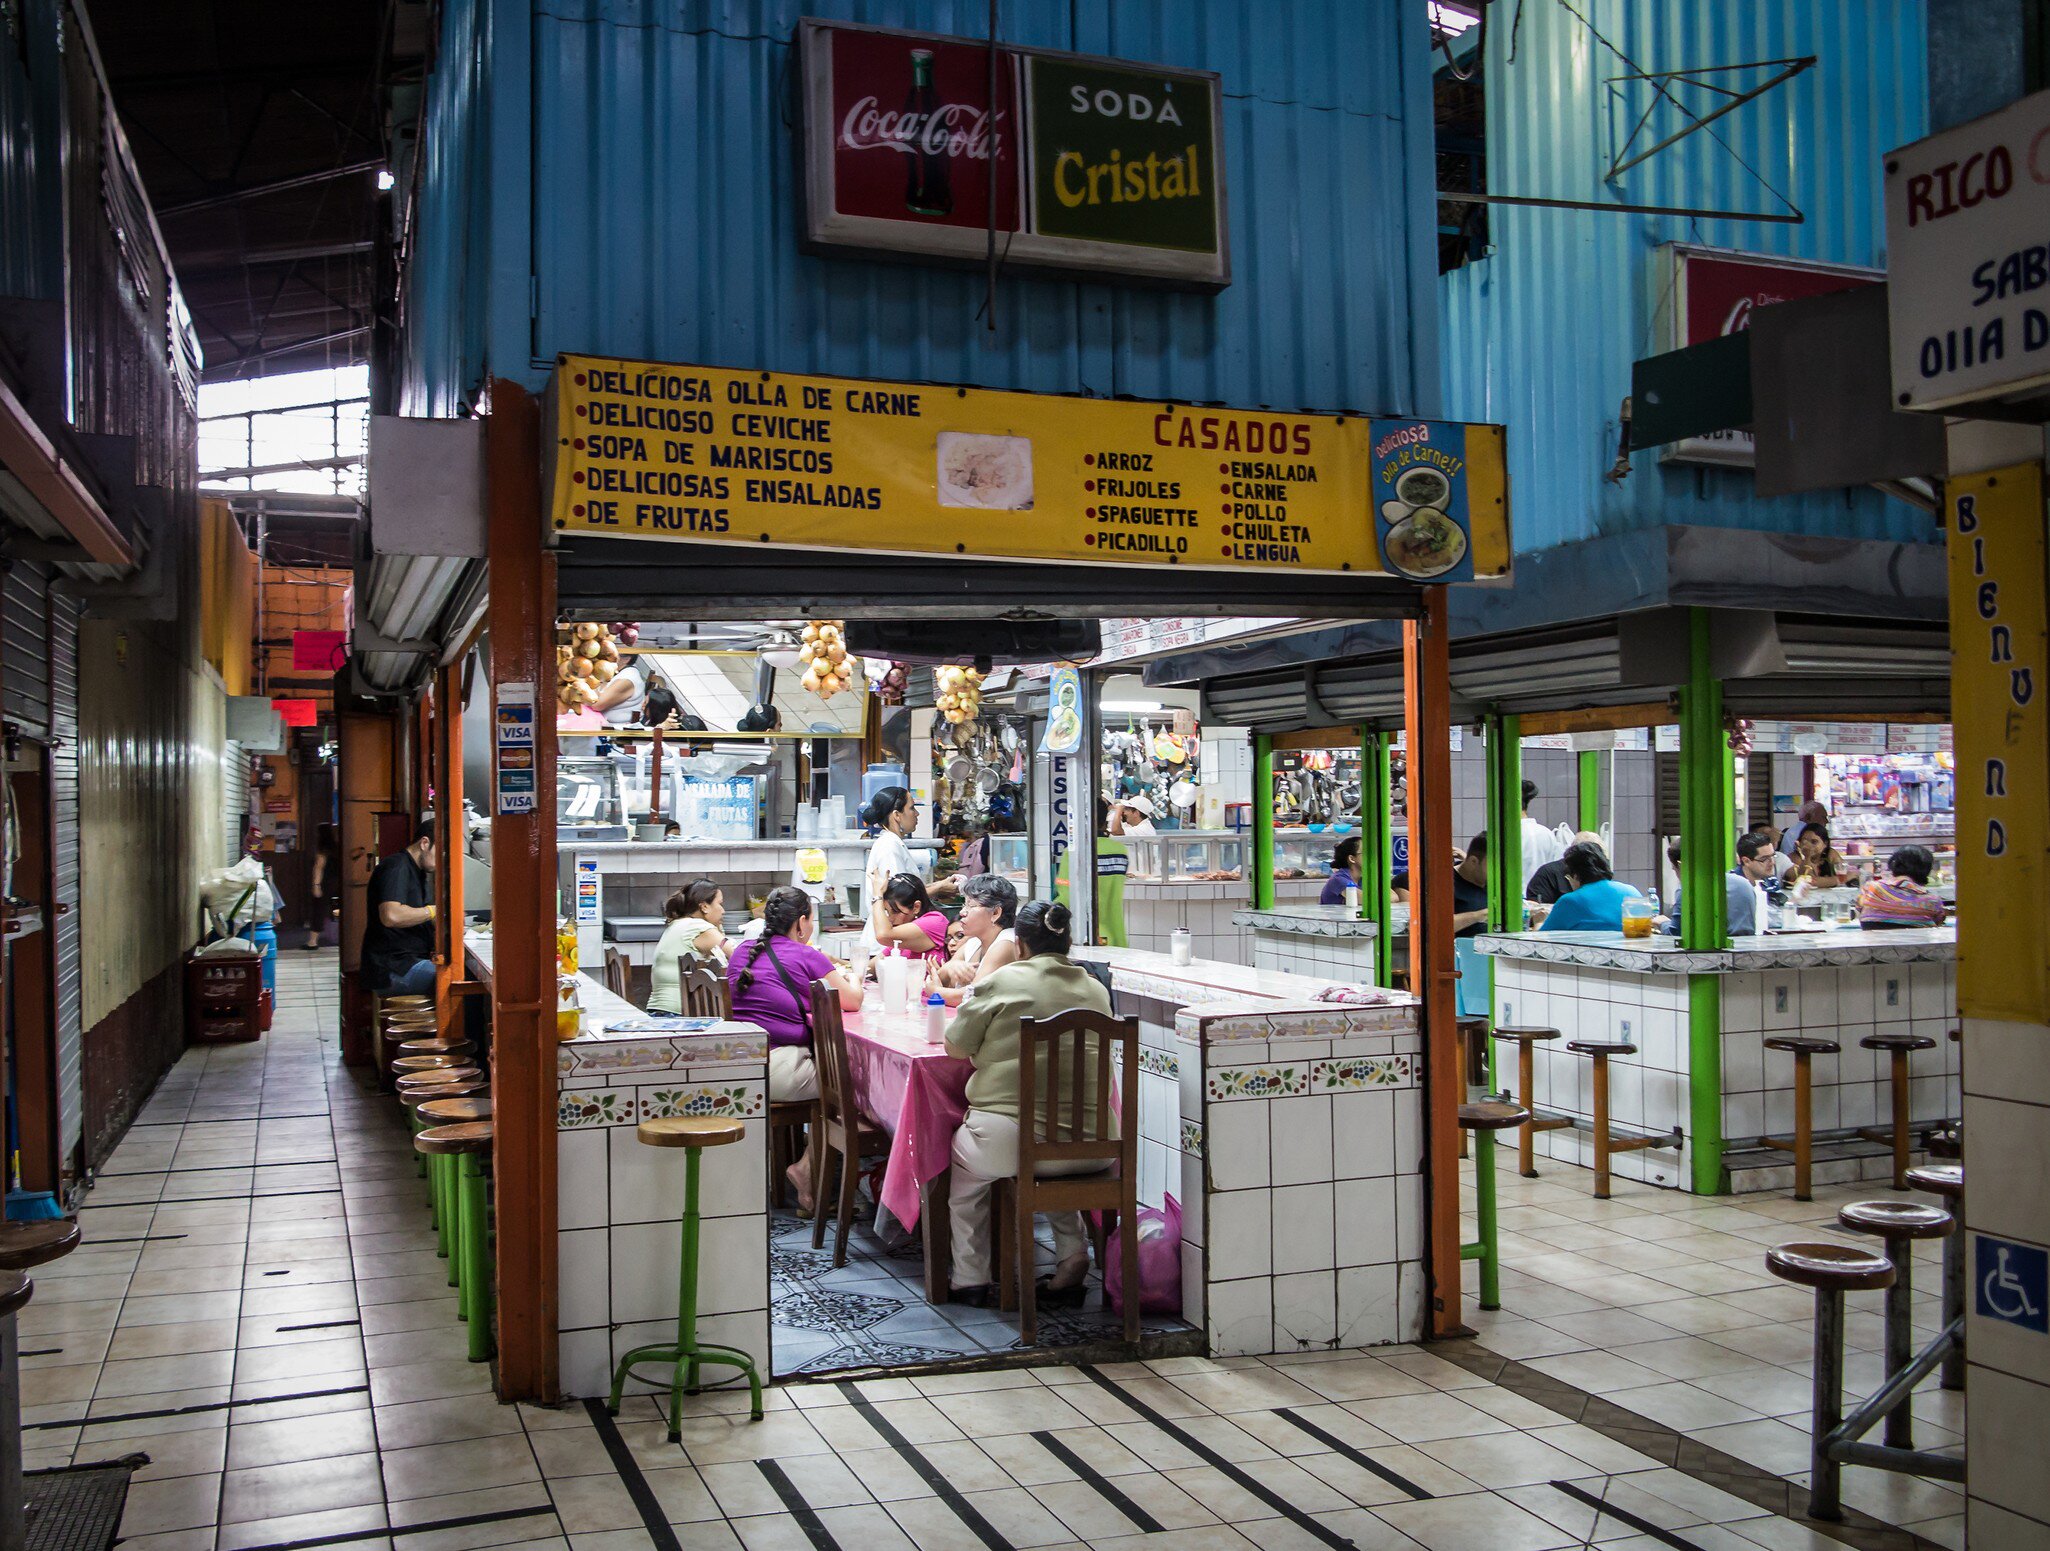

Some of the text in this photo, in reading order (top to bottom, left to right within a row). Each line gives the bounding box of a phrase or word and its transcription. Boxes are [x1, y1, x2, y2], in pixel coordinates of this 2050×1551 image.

[1070, 85, 1183, 127] SODA
[1053, 144, 1200, 207] Cristal
[1907, 145, 2013, 227] RICO
[1972, 241, 2050, 307] SAB
[588, 369, 921, 417] DELICIOSA OLLA DE CARNE
[588, 401, 831, 443] DELICIOSO CEVICHE
[1154, 413, 1311, 456] CASADOS
[587, 434, 833, 474] SOPA DE MARISCOS
[1097, 452, 1153, 472] ARROZ
[1231, 461, 1317, 483] ENSALADA
[587, 467, 881, 510] DELICIOSAS ENSALADAS
[1097, 478, 1181, 500] FRIJOLES
[1232, 481, 1288, 502] CARNE
[587, 500, 729, 532] DE FRUTAS
[1097, 505, 1199, 527] SPAGUETTE
[1233, 502, 1286, 522] POLLO
[1097, 532, 1188, 554] PICADILLO
[1233, 522, 1311, 543] CHULETA
[1233, 543, 1301, 563] LENGUA
[503, 727, 531, 738] VISA
[504, 796, 532, 807] VISA
[736, 783, 750, 798] DE
